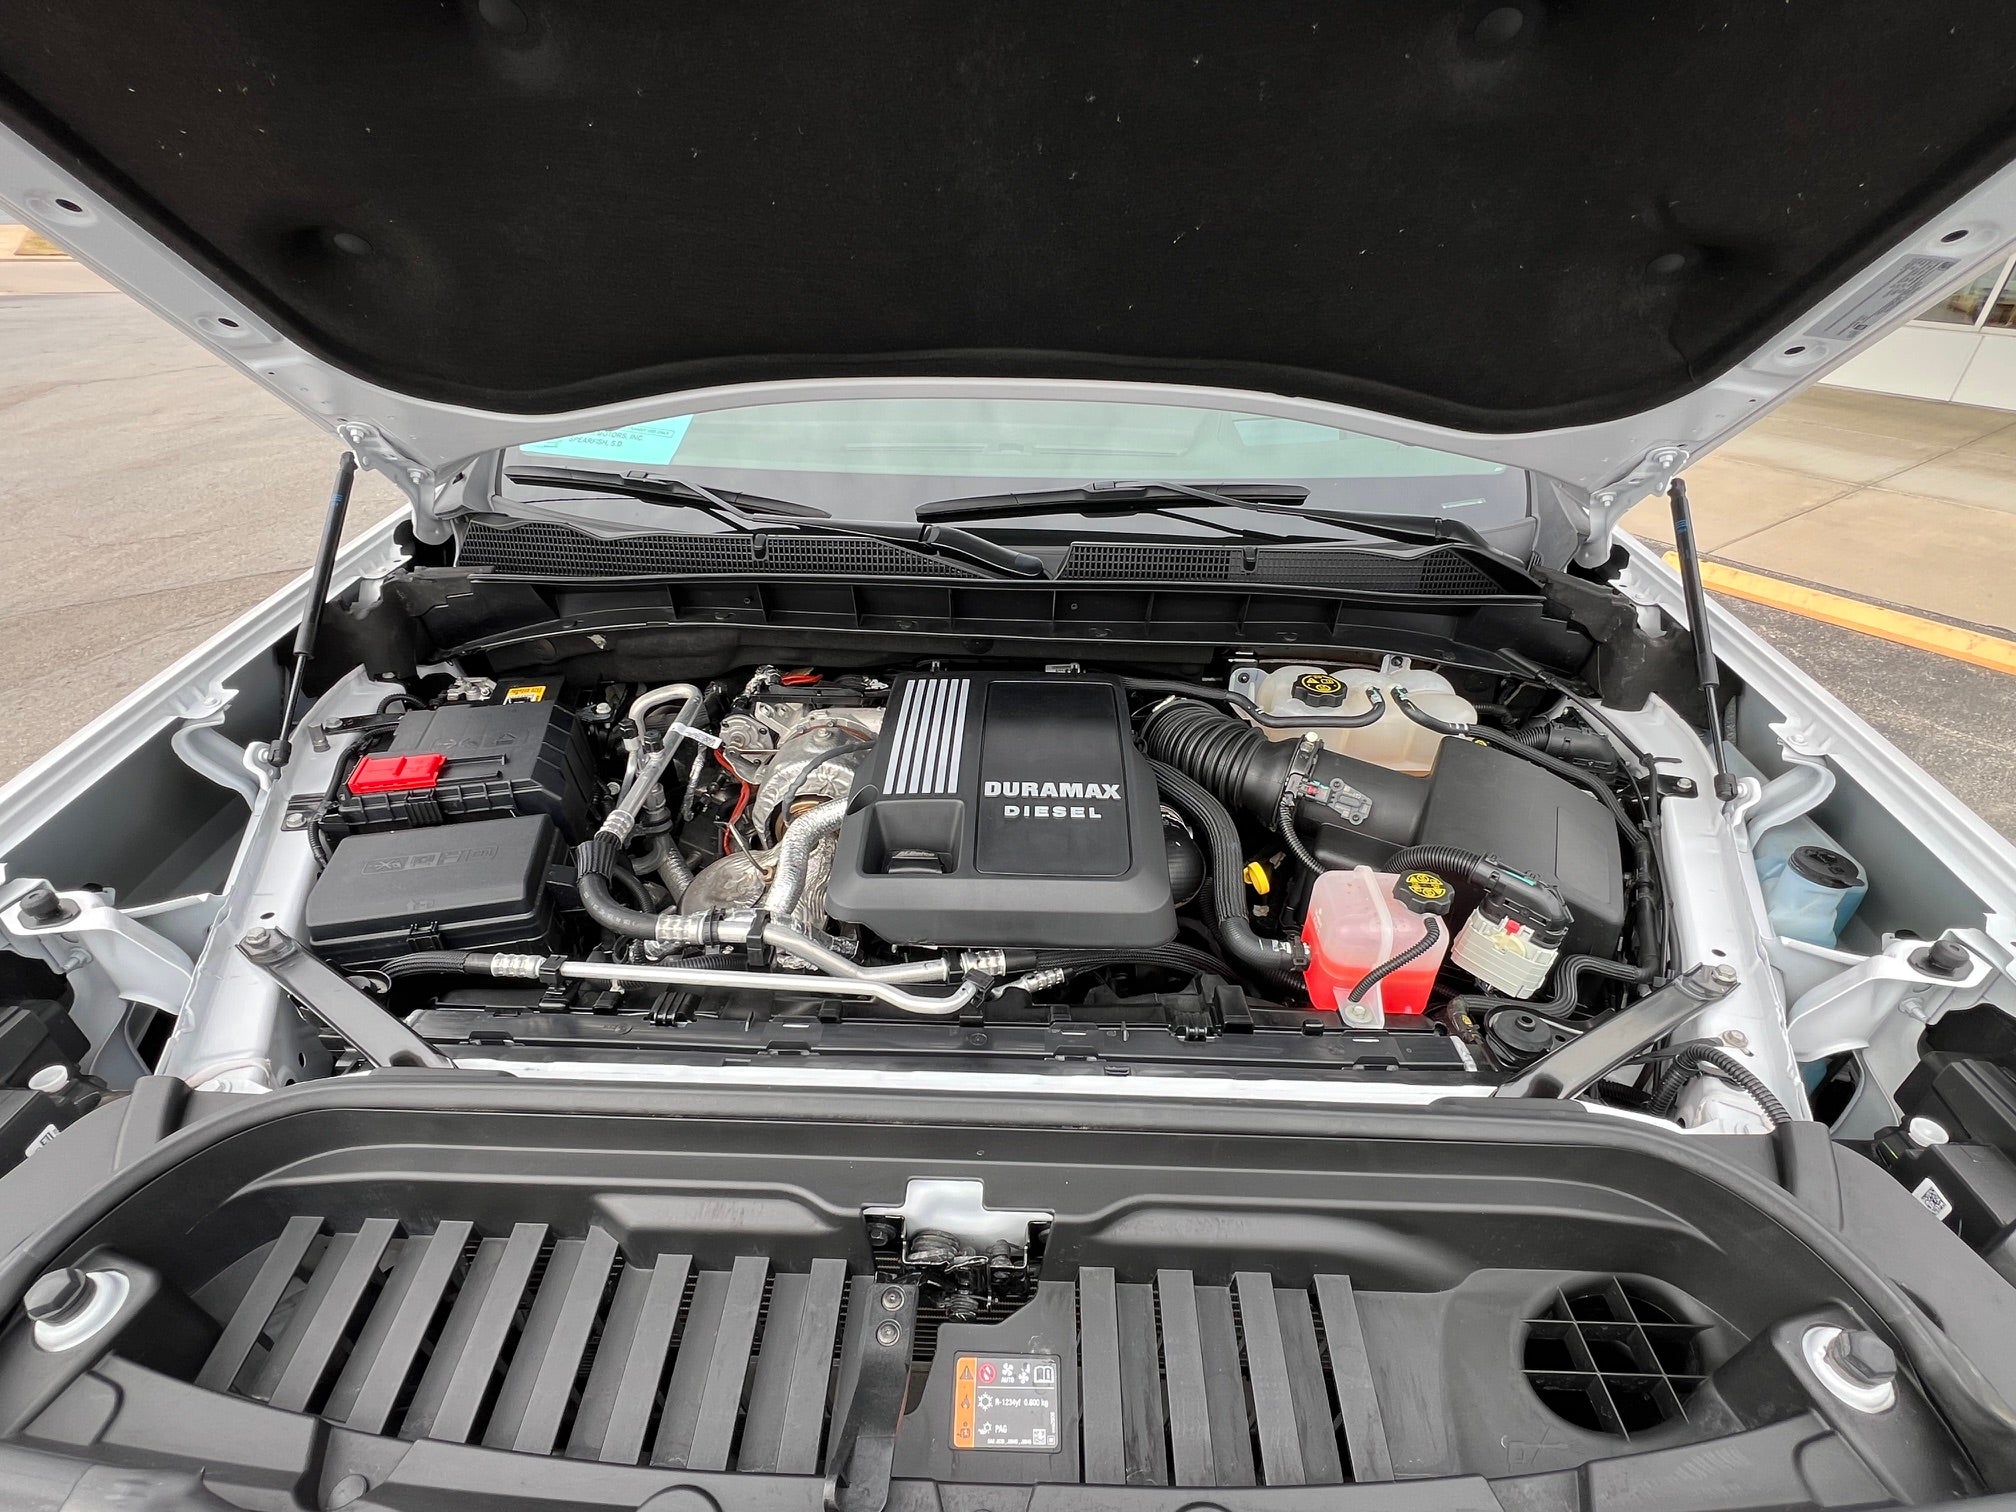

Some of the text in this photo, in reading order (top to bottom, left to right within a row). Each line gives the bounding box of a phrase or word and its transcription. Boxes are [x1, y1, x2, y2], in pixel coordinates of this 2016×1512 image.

[984, 781, 1121, 799] DURAMAX
[1004, 805, 1102, 818] DIESEL
[995, 1398, 1021, 1407] R-1234yf
[995, 1425, 1007, 1433] PAG
